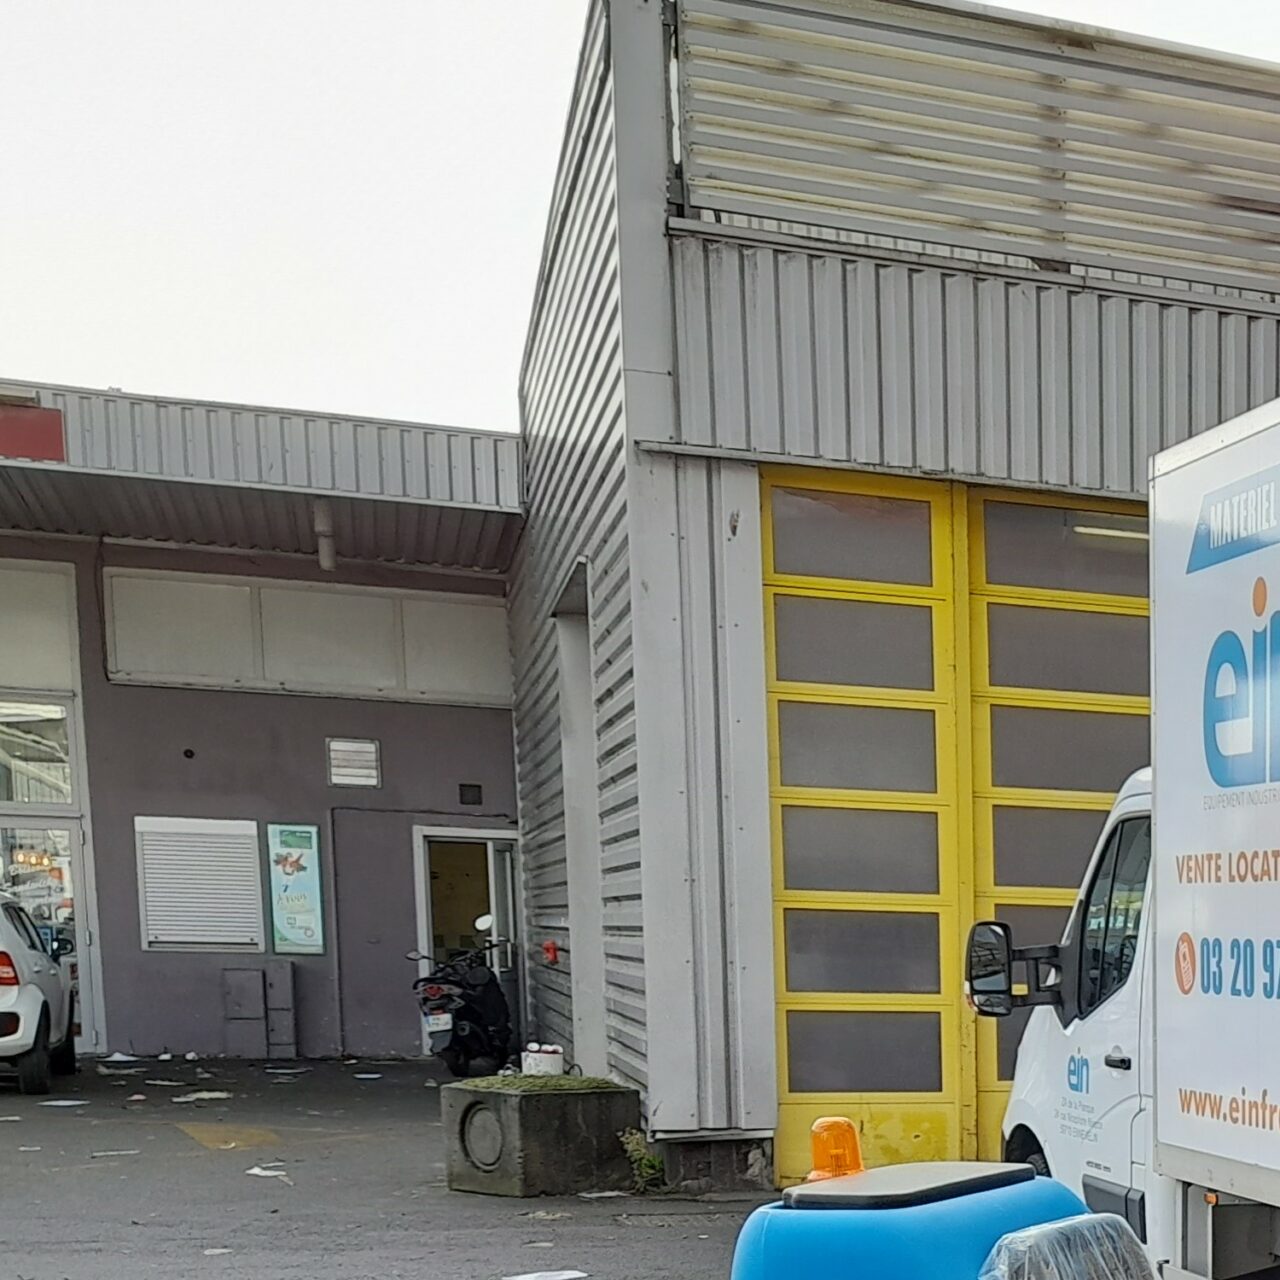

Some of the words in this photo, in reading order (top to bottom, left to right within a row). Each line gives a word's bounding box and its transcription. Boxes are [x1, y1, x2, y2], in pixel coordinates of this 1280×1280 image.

[1209, 481, 1278, 549] MATERIEL
[1176, 853, 1222, 884] VENTE
[1200, 937, 1223, 995] 03
[1230, 938, 1255, 998] 20
[1067, 1047, 1090, 1094] ein
